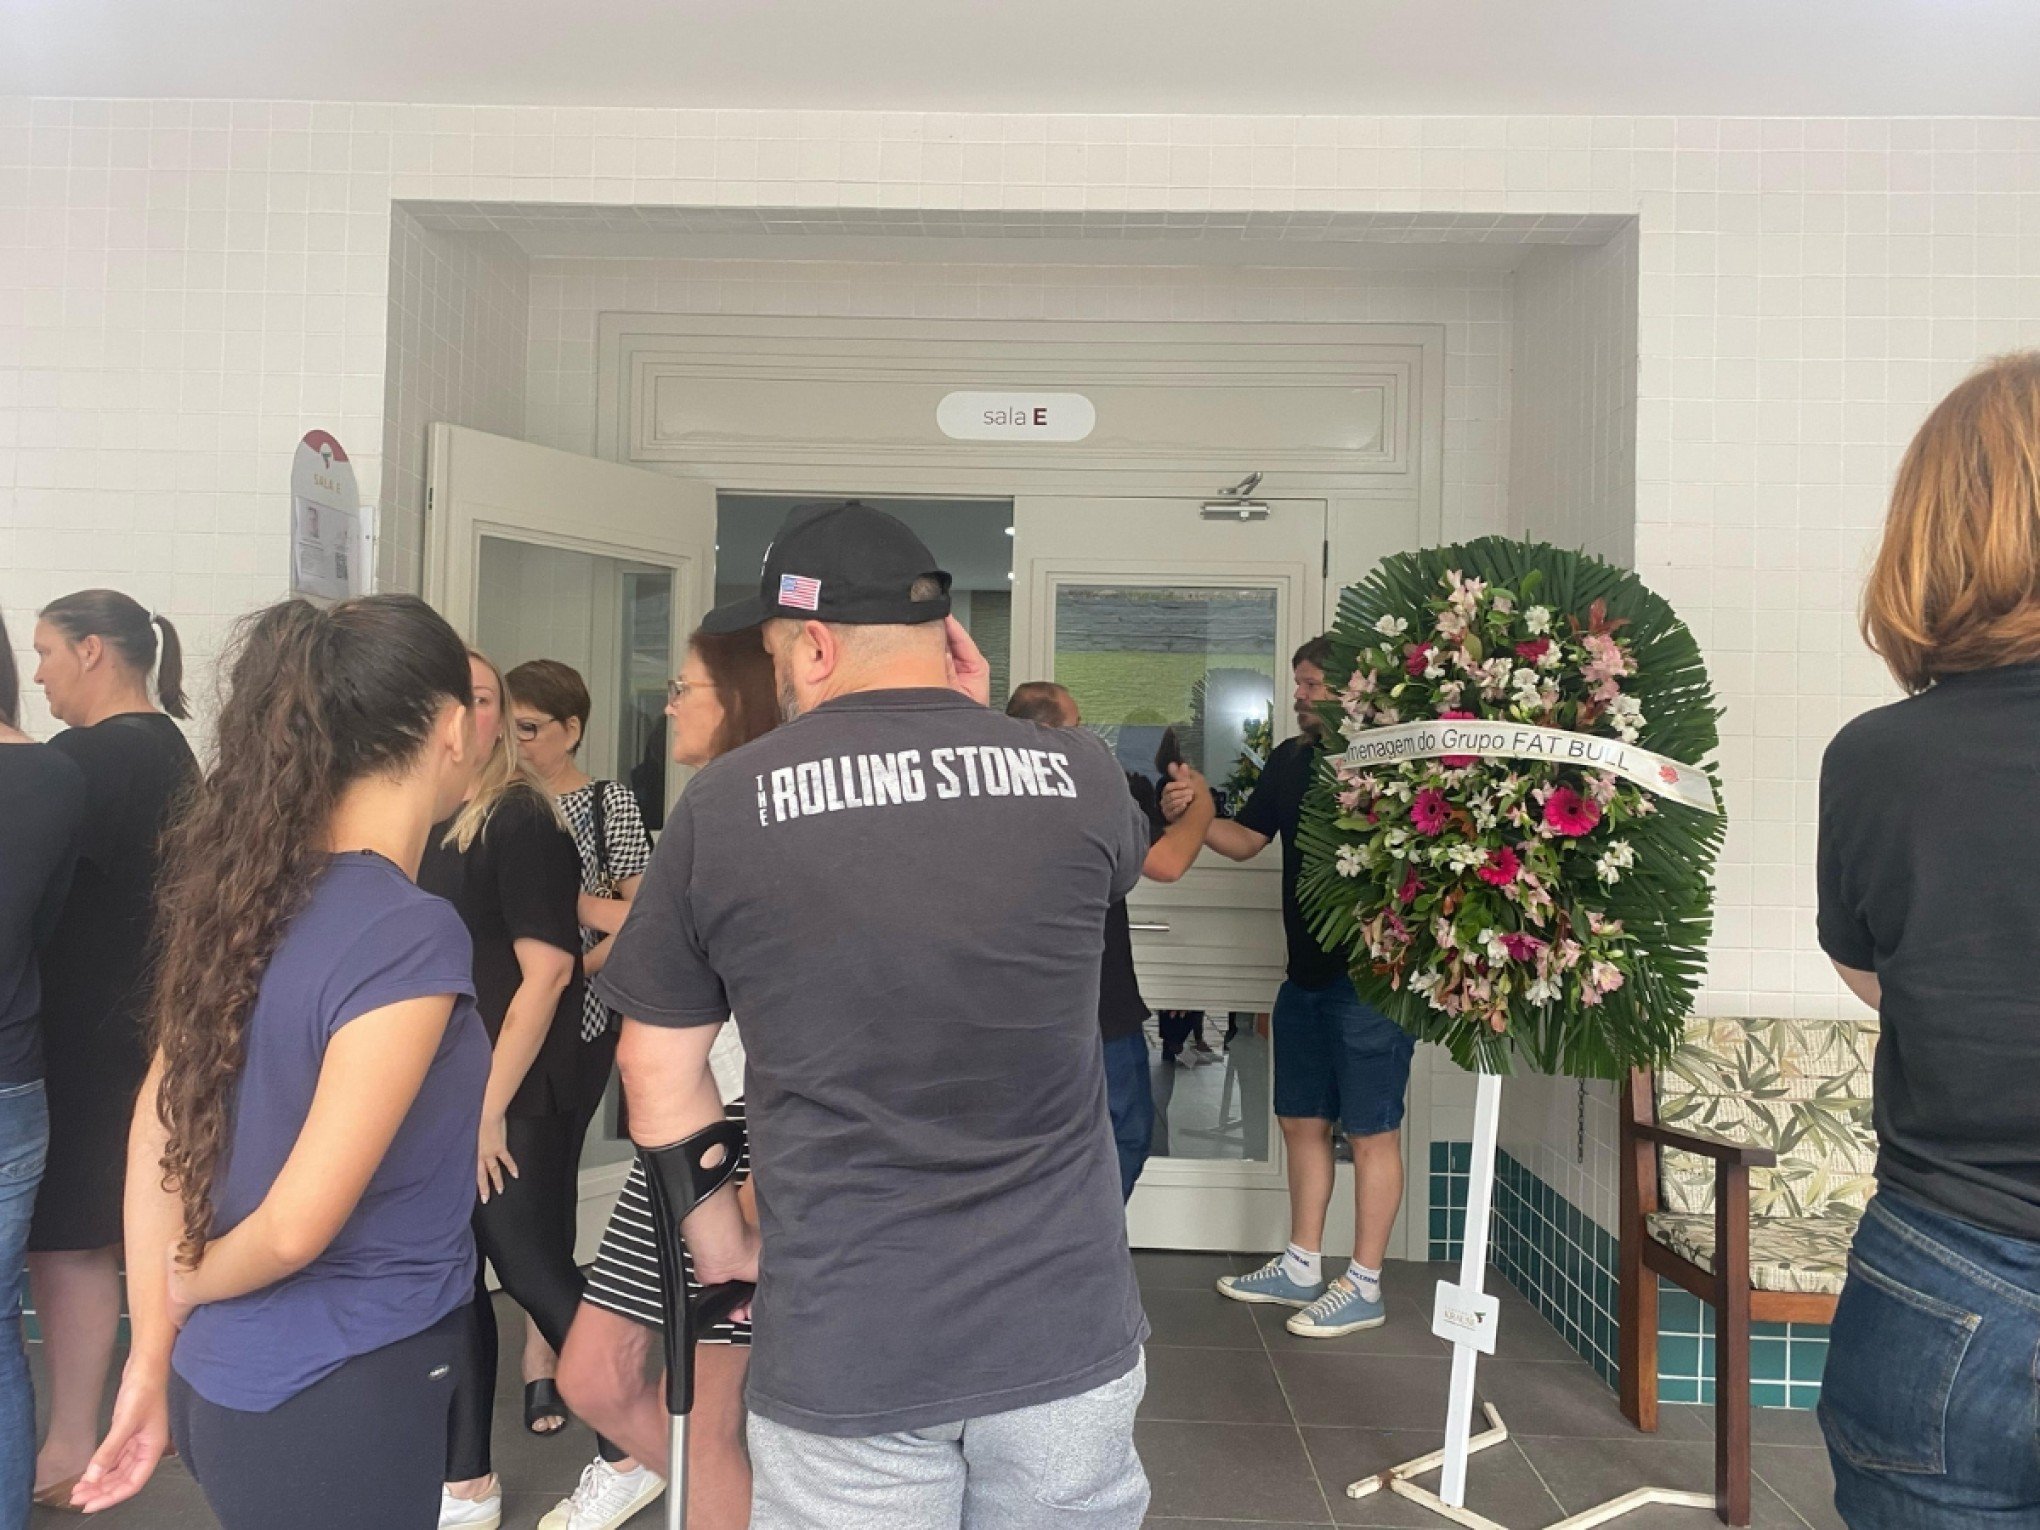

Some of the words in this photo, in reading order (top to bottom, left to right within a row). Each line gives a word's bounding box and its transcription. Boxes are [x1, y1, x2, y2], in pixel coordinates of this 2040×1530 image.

[983, 406, 1026, 426] sala
[1033, 407, 1048, 426] E
[1417, 731, 1436, 751] do
[1441, 728, 1505, 753] Grupo
[1512, 732, 1562, 754] FAT
[1568, 740, 1630, 772] BULL
[756, 774, 769, 827] THE
[771, 749, 927, 822] ROLLING
[931, 745, 1077, 799] STONES
